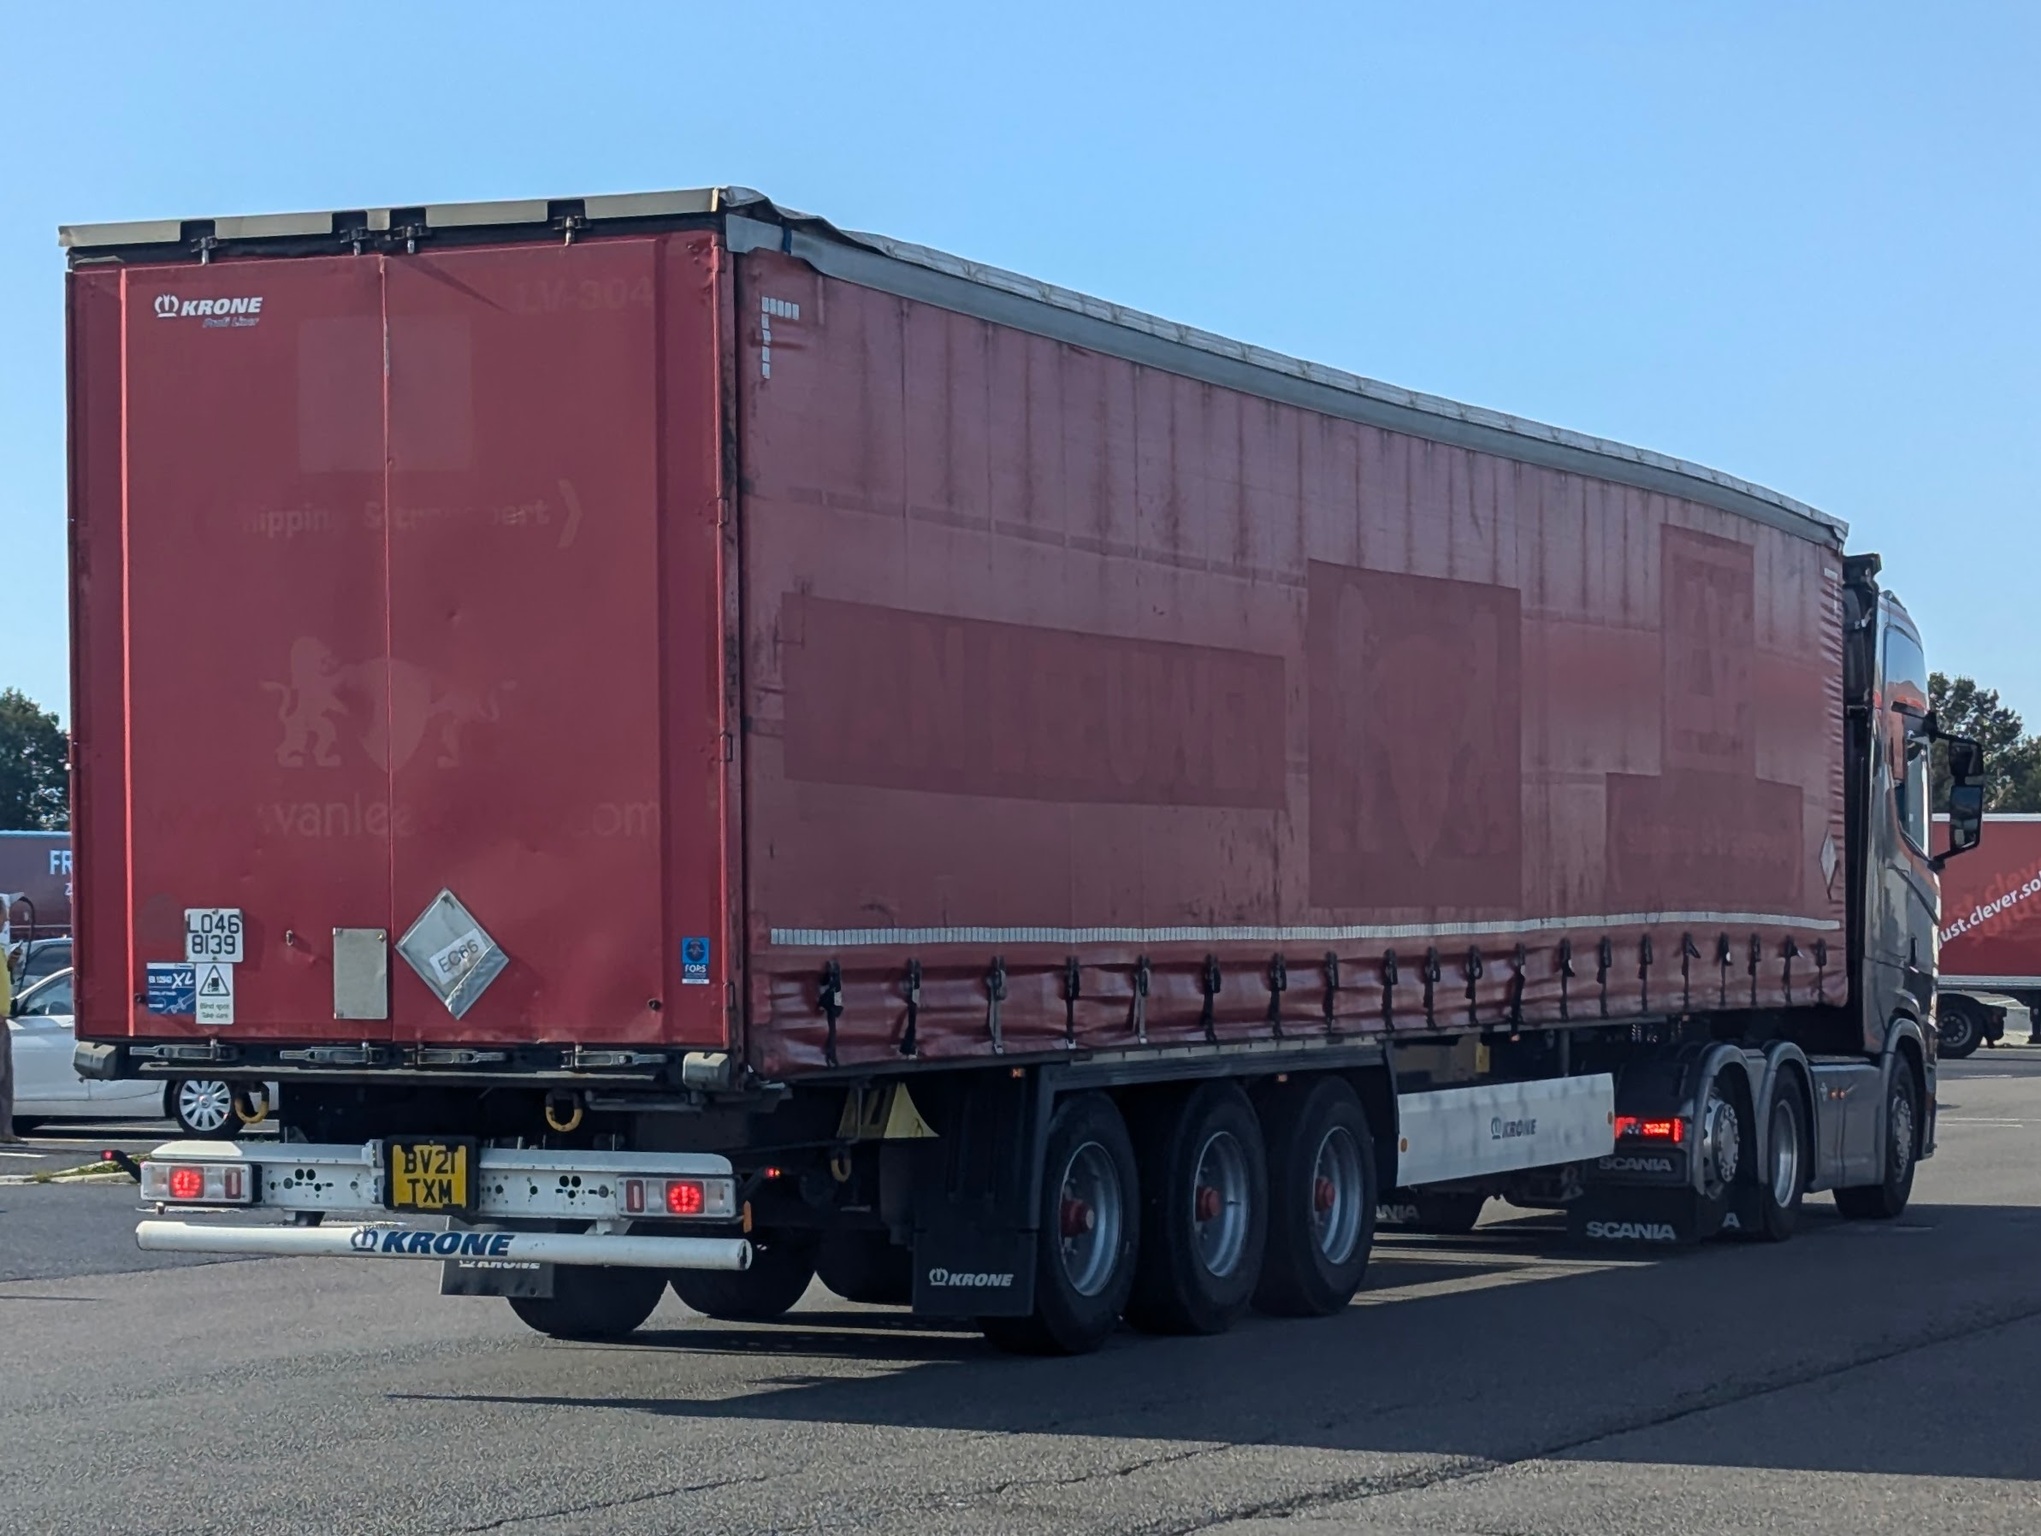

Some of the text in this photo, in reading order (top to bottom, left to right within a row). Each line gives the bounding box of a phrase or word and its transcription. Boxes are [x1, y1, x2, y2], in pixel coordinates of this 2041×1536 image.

[180, 297, 263, 316] KRONE
[192, 934, 236, 955] 8139
[171, 971, 194, 990] XL
[1502, 1119, 1536, 1138] KRONE
[403, 1149, 456, 1175] BV21
[1599, 1157, 1672, 1172] SCANIA
[407, 1178, 453, 1204] TXM
[1586, 1221, 1677, 1240] SCANIA
[382, 1231, 515, 1256] KRONE
[948, 1273, 1014, 1287] KRONE
